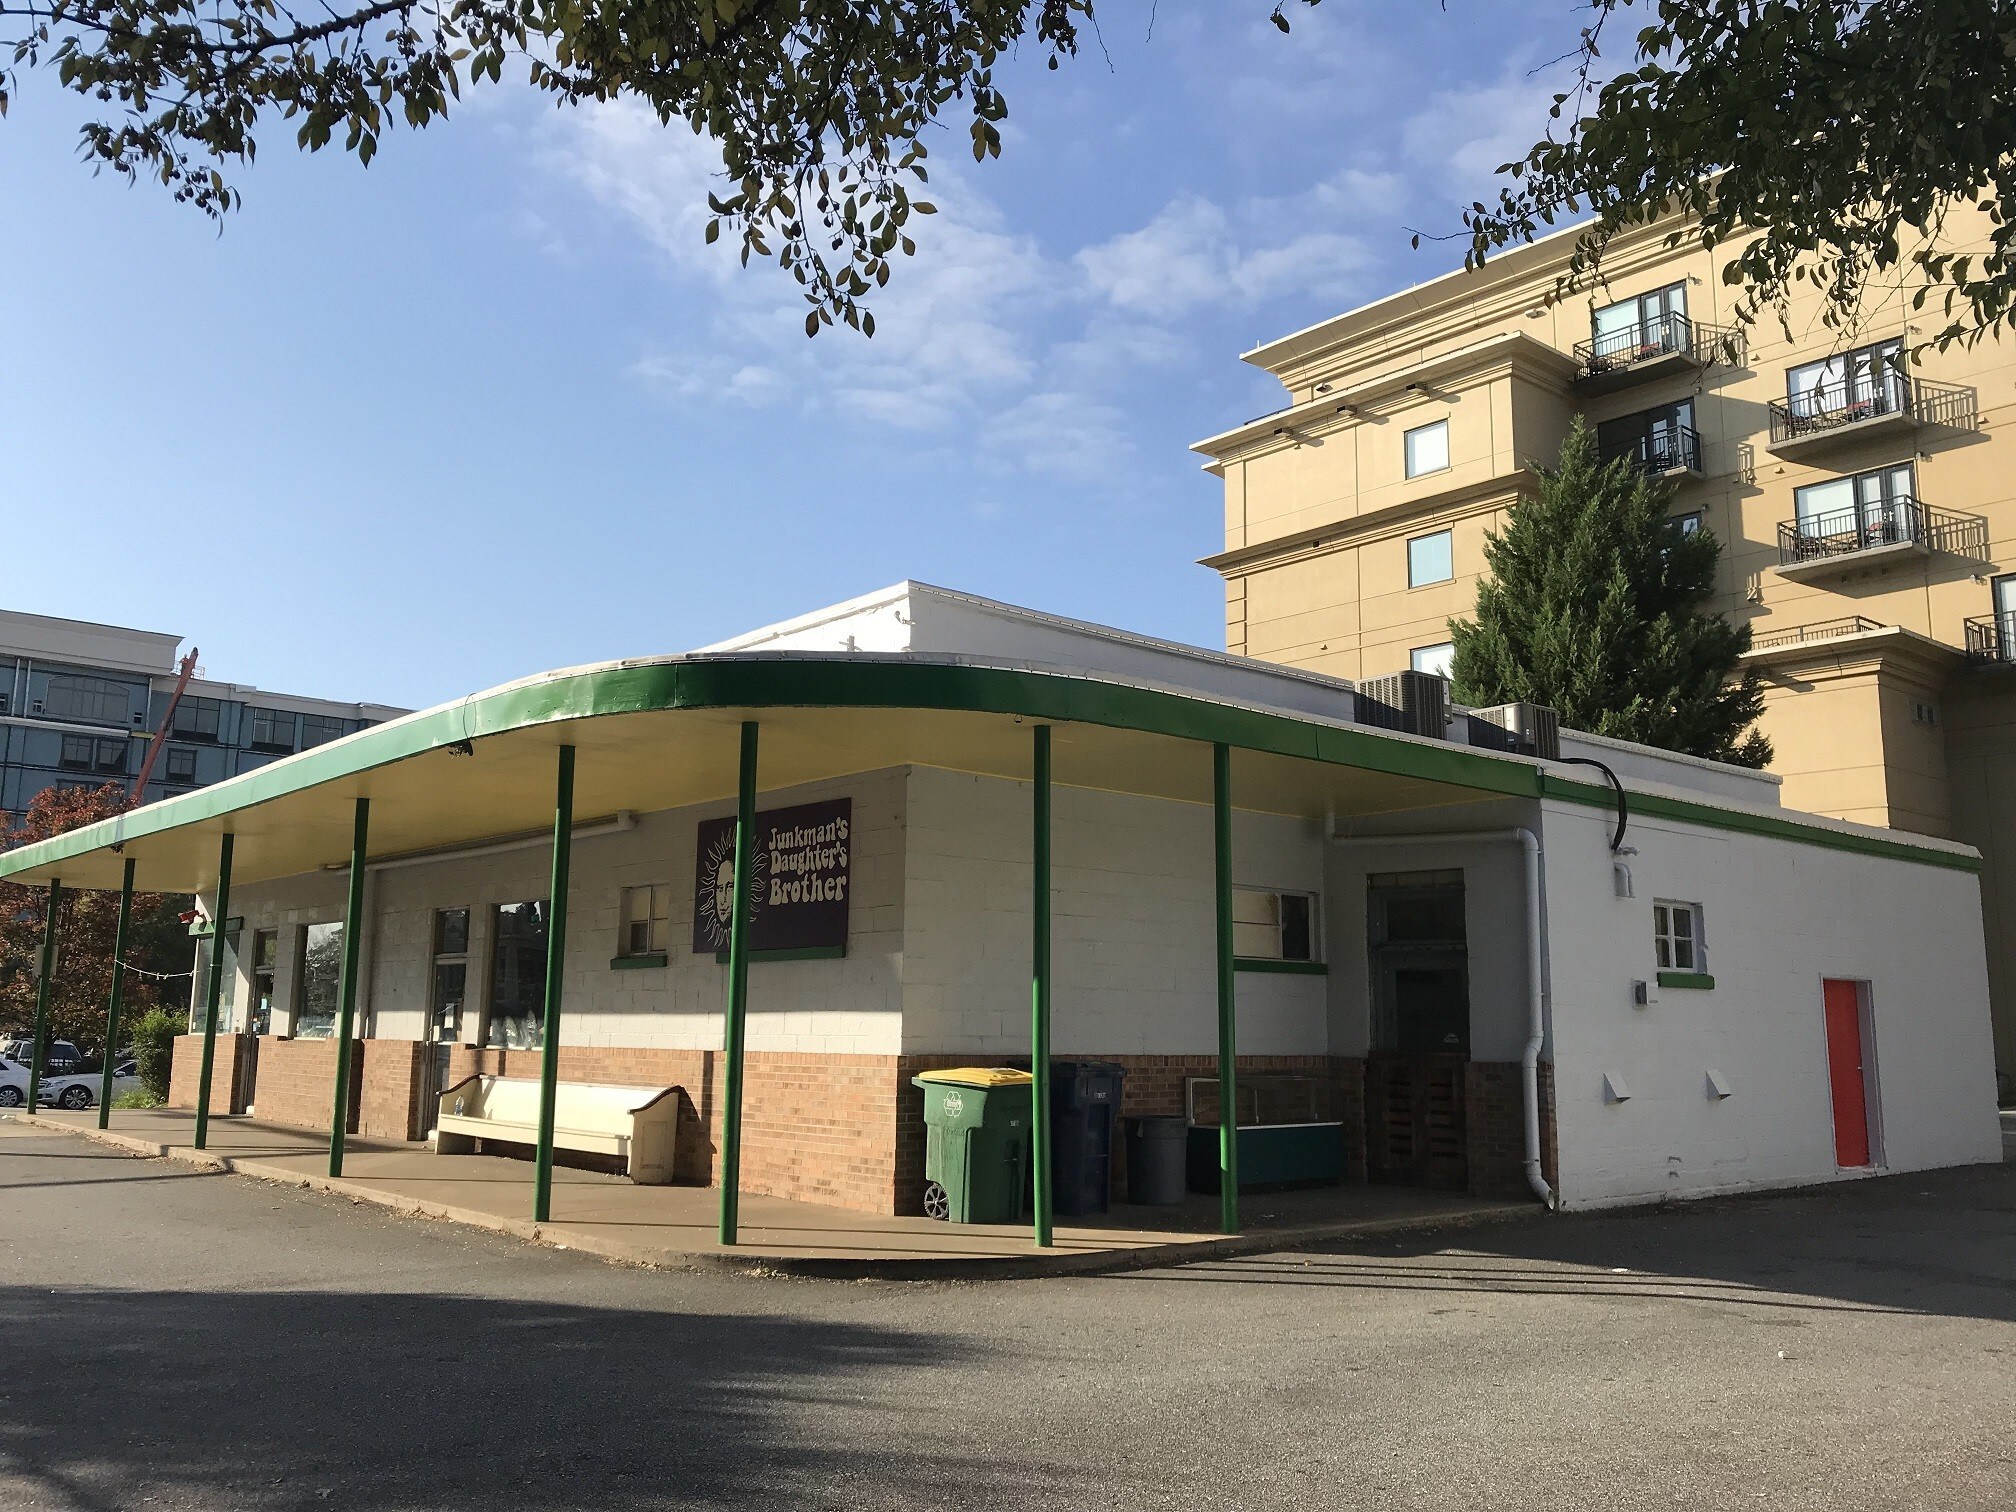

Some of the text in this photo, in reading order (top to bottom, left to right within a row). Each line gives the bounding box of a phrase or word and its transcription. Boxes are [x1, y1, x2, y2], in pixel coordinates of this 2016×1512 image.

[769, 817, 848, 850] Junkman's
[770, 841, 847, 875] Daughter's
[769, 873, 846, 905] Brother
